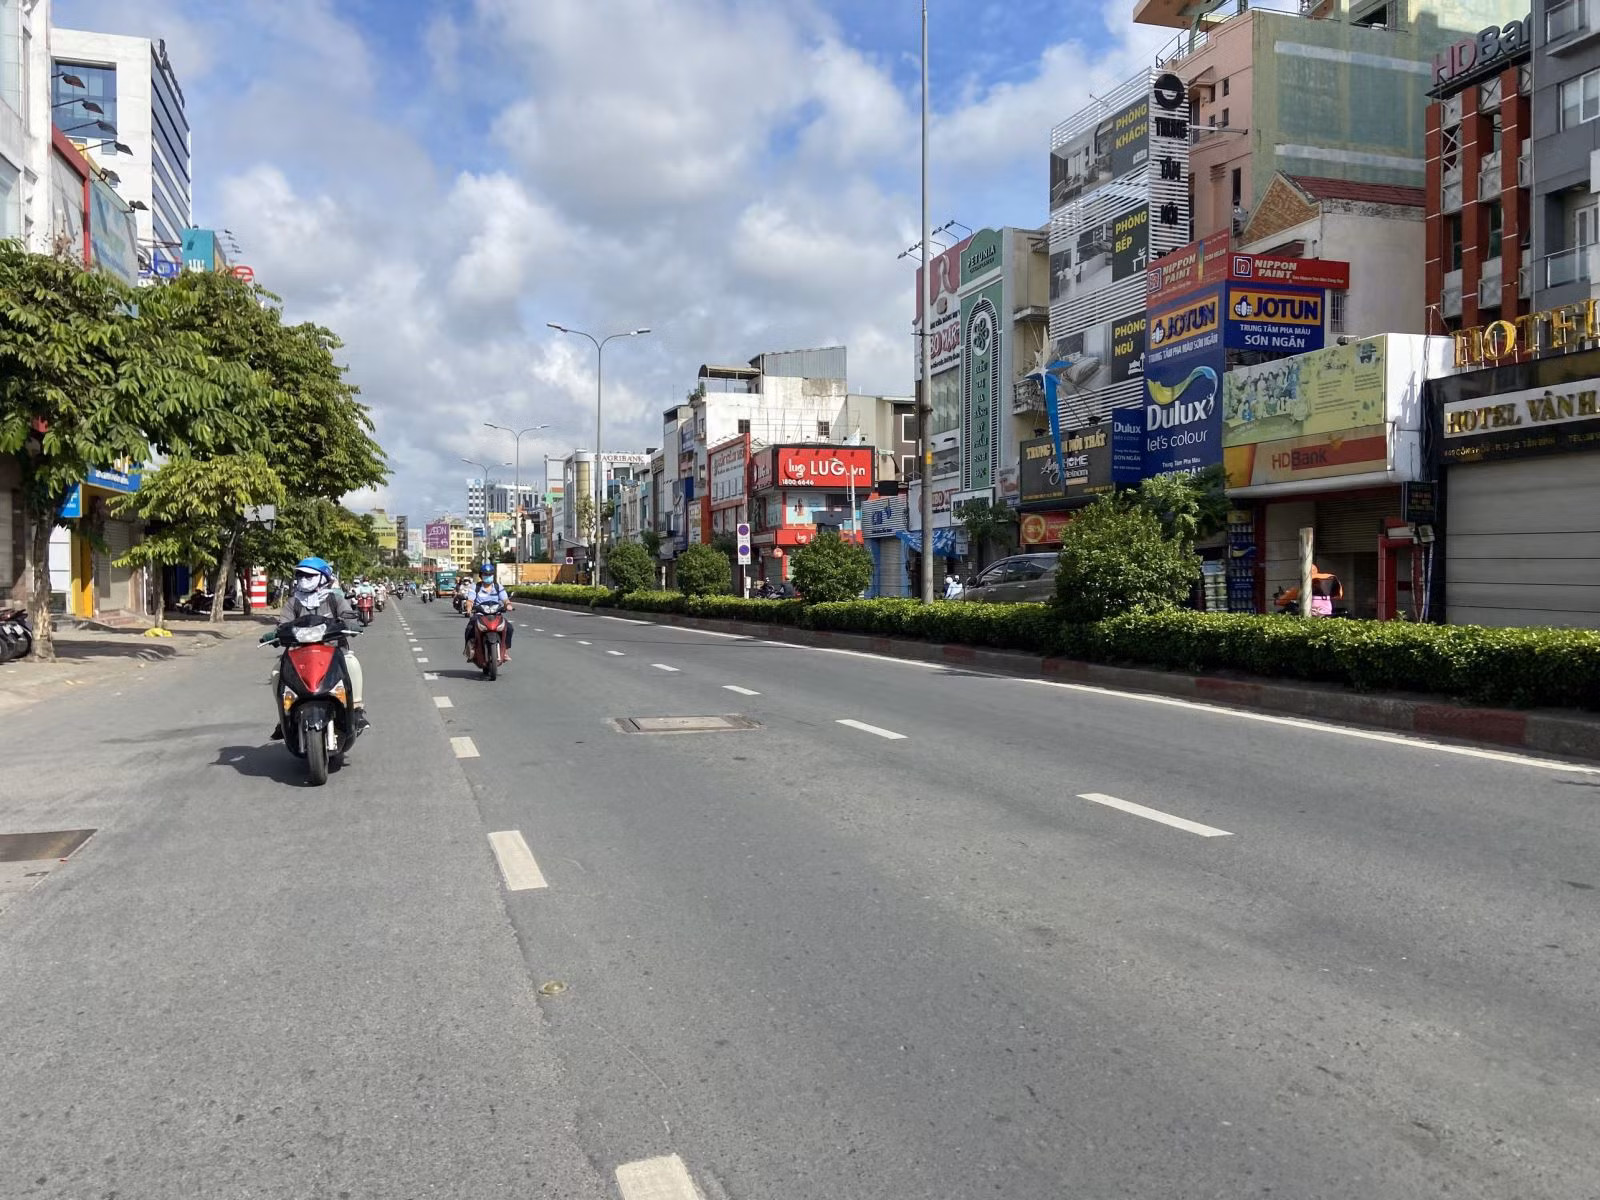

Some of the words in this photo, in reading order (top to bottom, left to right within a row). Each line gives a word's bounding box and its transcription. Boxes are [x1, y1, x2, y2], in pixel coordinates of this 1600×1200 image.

[1115, 104, 1148, 131] PHÒNG
[1155, 117, 1188, 139] TRUNG
[1115, 122, 1148, 149] KHÁCH
[1115, 211, 1147, 235] PHÒNG
[1115, 234, 1133, 253] BẾP
[1162, 253, 1196, 275] NIPPON
[1165, 266, 1191, 284] PAINT
[1254, 260, 1297, 271] NIPPON
[1258, 269, 1292, 279] PAINT
[1254, 297, 1318, 320] JOTUN
[1114, 318, 1147, 339] PHÒNG
[1165, 302, 1215, 340] JOTUN
[1240, 323, 1262, 332] TRUNG
[1264, 324, 1278, 333] TÂM
[1280, 326, 1293, 334] PHA
[1295, 326, 1310, 335] MÀU
[1114, 338, 1134, 357] NGỦ
[1245, 334, 1269, 345] SƠN
[1272, 335, 1305, 348] NGÂN
[1147, 399, 1208, 431] Dulux
[1446, 403, 1522, 434] HOTEL
[1526, 390, 1576, 422] VÂN
[1578, 390, 1600, 416] H
[1114, 421, 1142, 434] Dulux
[1147, 435, 1168, 452] let's
[1170, 430, 1208, 447] colour
[1271, 447, 1328, 470] HDBank
[782, 478, 797, 486] 1800
[797, 478, 815, 486] 6646
